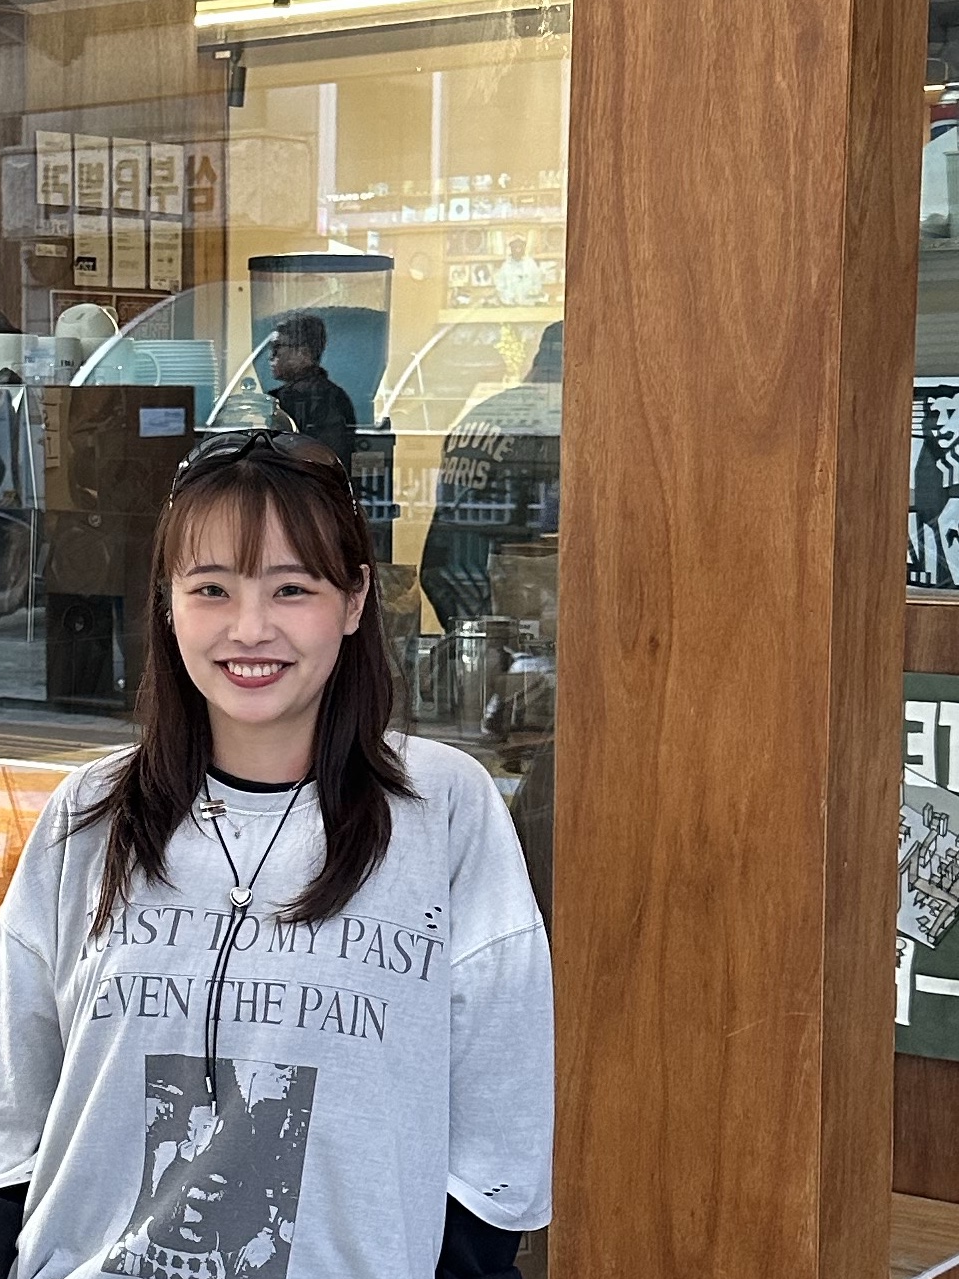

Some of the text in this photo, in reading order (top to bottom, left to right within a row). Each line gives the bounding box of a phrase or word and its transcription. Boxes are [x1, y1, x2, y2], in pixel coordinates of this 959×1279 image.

[204, 911, 260, 952] TO
[266, 914, 327, 954] MY
[337, 916, 445, 982] PAST
[90, 975, 389, 1043] EVEN THE PAIN
